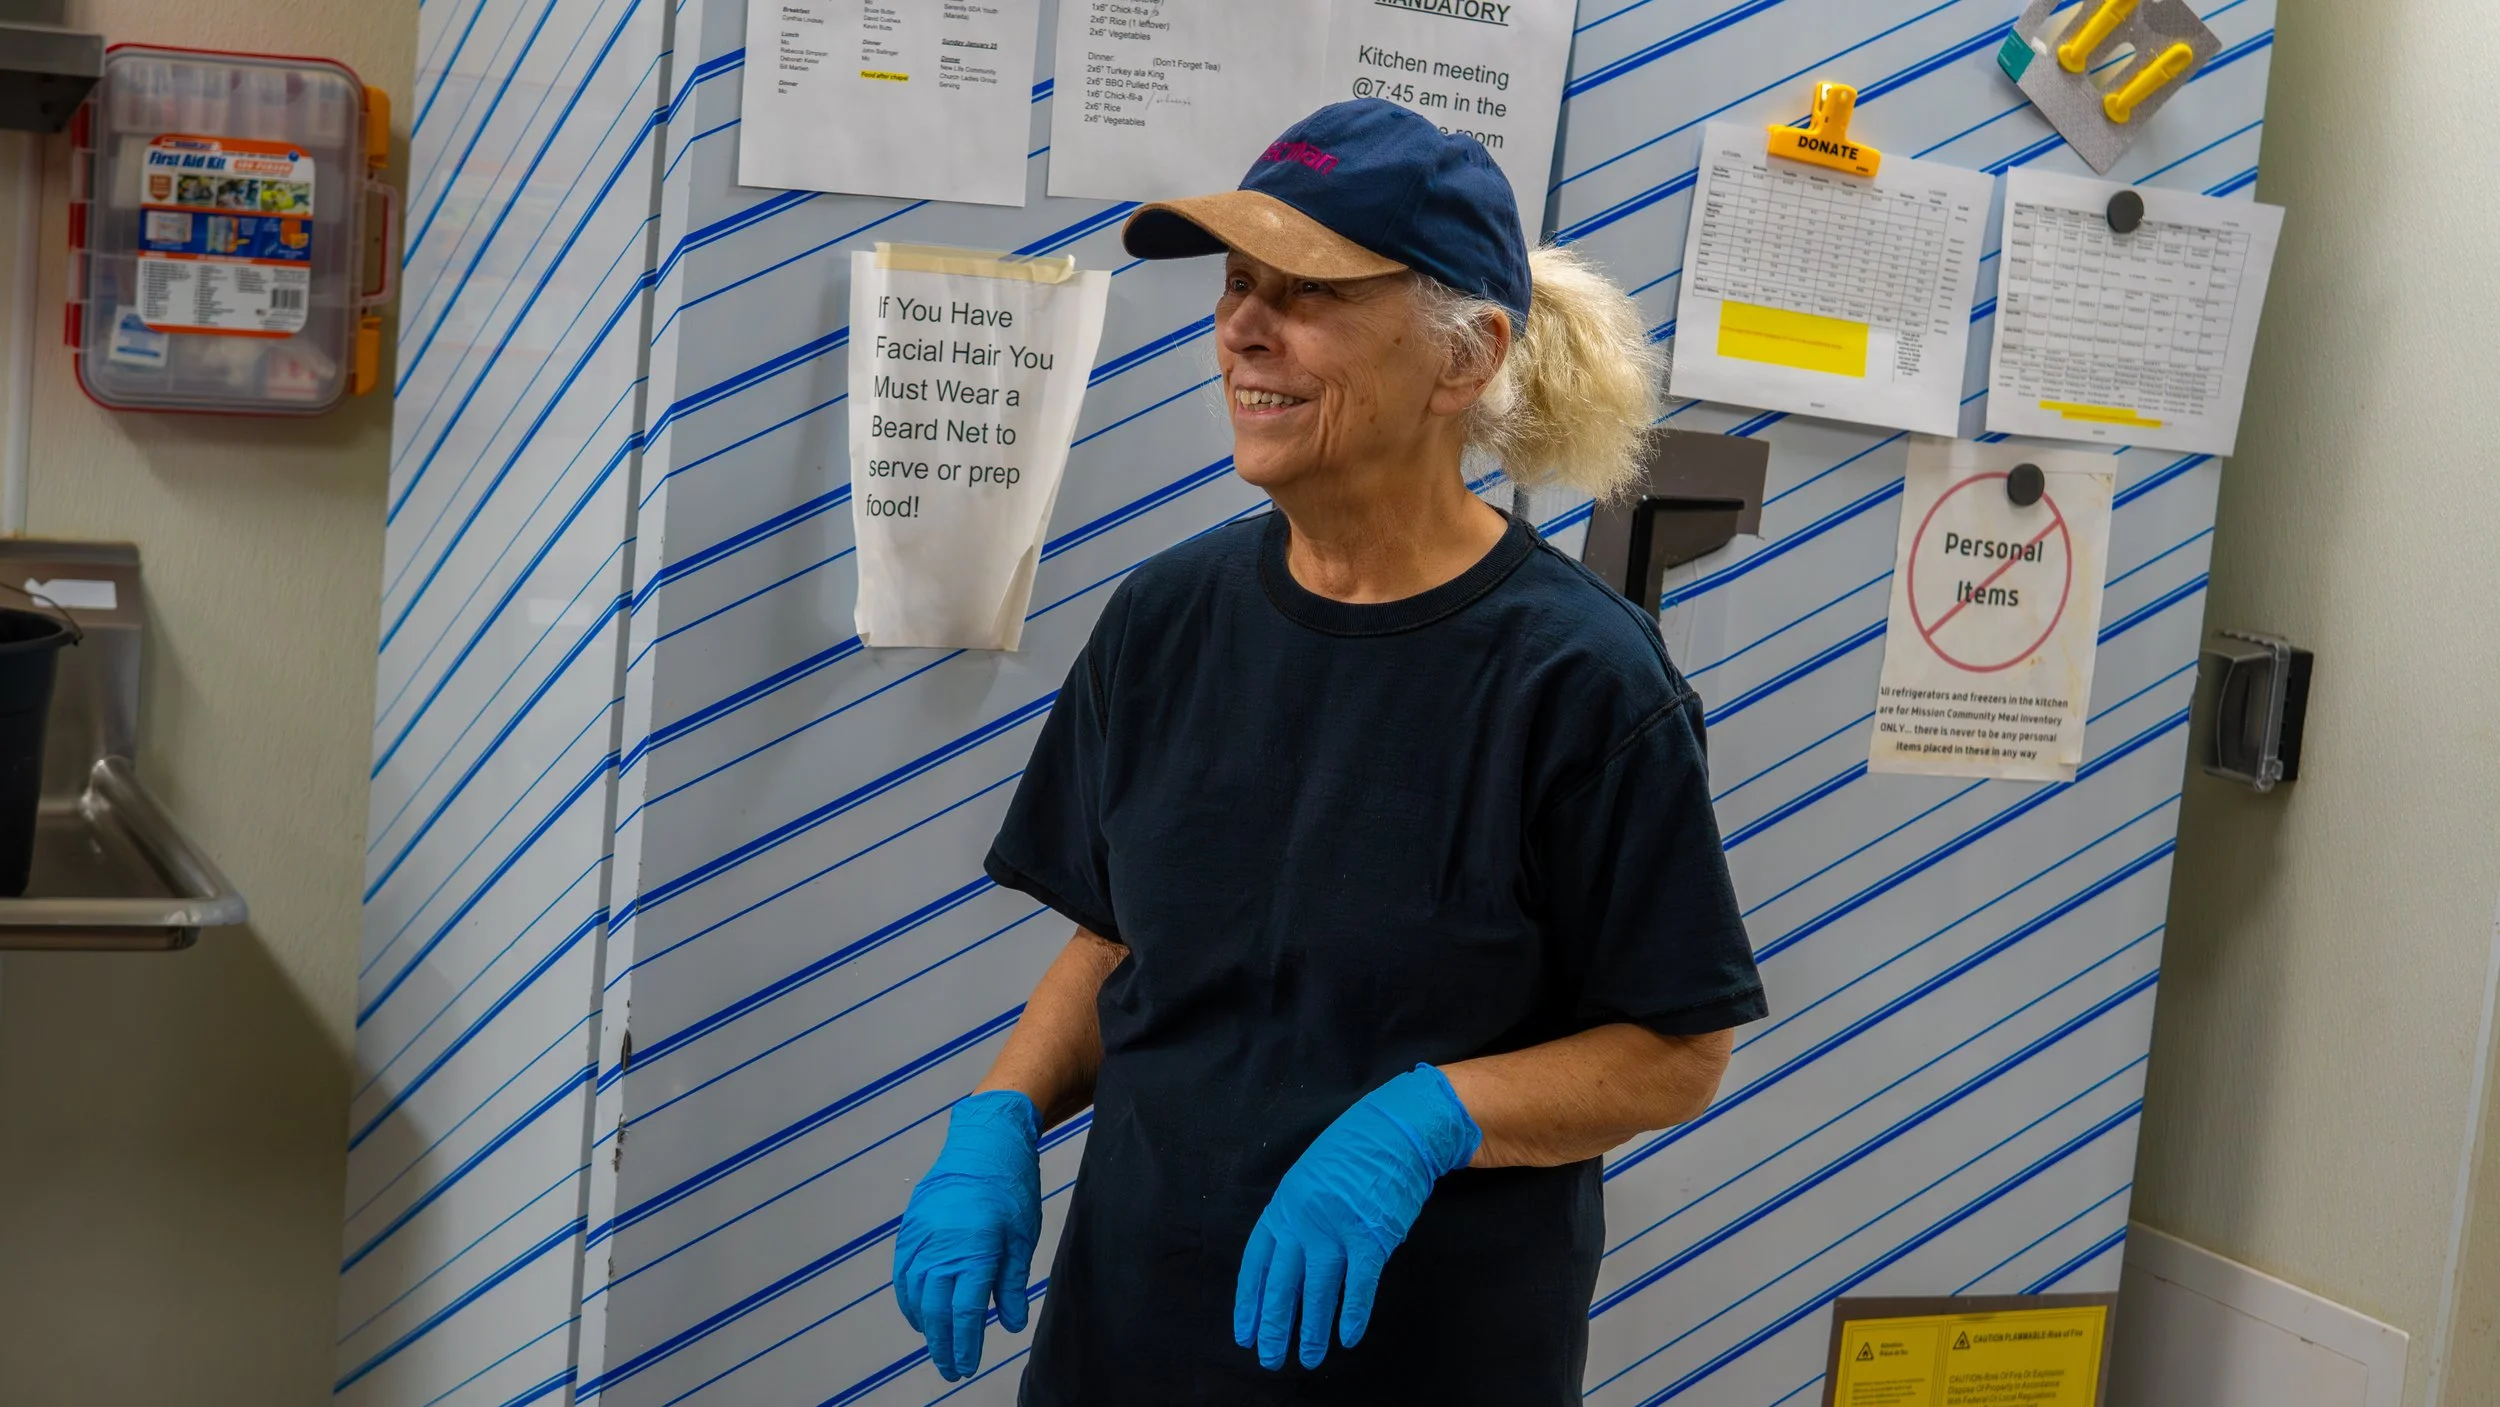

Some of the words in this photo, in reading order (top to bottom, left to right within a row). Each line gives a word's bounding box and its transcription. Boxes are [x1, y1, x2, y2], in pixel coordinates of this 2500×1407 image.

[1092, 3, 1108, 11] 1x6"
[1110, 6, 1148, 16] Chick-fil-a
[1090, 15, 1108, 24] 2x6"
[1109, 17, 1127, 26] Rice
[1089, 28, 1107, 36] 2x6"
[1108, 30, 1151, 40] Vegetables
[966, 67, 996, 75] Community
[1087, 65, 1104, 73] 2x6"
[1107, 66, 1132, 77] Turkey
[1148, 70, 1165, 80] King
[1178, 60, 1202, 71] Forget
[1205, 62, 1221, 73] Tea)
[1358, 45, 1428, 74] Kitchen
[1433, 61, 1510, 91] meeting
[1086, 77, 1103, 86] 2x6"
[1105, 79, 1123, 88] BBQ
[1126, 80, 1149, 90] Pulled
[1151, 82, 1169, 91] Pork
[1104, 91, 1143, 101] Chick-fil-a
[1352, 77, 1414, 103] @7:45
[1419, 90, 1448, 109] am
[1454, 93, 1470, 112] in
[1476, 96, 1507, 118] the
[1085, 102, 1102, 111] 2x6"
[1104, 103, 1121, 112] Rice
[1084, 114, 1101, 122] 2x6"
[1103, 116, 1145, 126] Vegetables
[1798, 135, 1859, 161] DONATE
[149, 152, 180, 167] First
[182, 154, 206, 168] Aid
[206, 157, 227, 170] Kit
[878, 296, 890, 319] If
[896, 297, 942, 323] You
[951, 301, 1013, 328] Have
[875, 336, 944, 363] Facial
[952, 341, 1002, 366] Hair
[1009, 345, 1054, 371] You
[874, 375, 928, 401] Must
[936, 380, 999, 406] Wear
[1006, 386, 1020, 407] a
[872, 416, 938, 442] Beard
[946, 420, 988, 445] Net
[996, 424, 1016, 445] to
[868, 458, 929, 479] serve
[937, 462, 961, 482] or
[969, 463, 1021, 489] prep
[866, 494, 920, 518] food!
[1944, 532, 2043, 563] Personal
[1957, 581, 2019, 607] Items
[1892, 688, 1950, 701] refrigerators
[1952, 693, 1968, 703] and
[1970, 694, 2007, 705] freezers
[2009, 695, 2017, 704] in
[2019, 697, 2033, 706] the
[2035, 698, 2068, 709] kitchen
[1879, 705, 1893, 714] are
[1896, 705, 1909, 715] for
[1911, 707, 1945, 718] Mission
[1947, 709, 1996, 722] Community
[1999, 713, 2019, 722] Meal
[1914, 726, 1939, 736] there
[1940, 726, 1948, 736] is
[1950, 728, 1975, 738] never
[1978, 729, 1987, 738] to
[1989, 729, 1999, 739] be
[2001, 731, 2017, 741] any
[2019, 732, 2057, 743] personal
[1923, 743, 1953, 754] placed
[1955, 744, 1963, 754] in
[1965, 745, 1989, 756] these
[1991, 747, 2000, 756] in
[2001, 748, 2017, 758] any
[2020, 749, 2037, 759] way
[1973, 1334, 2004, 1343] CAUTION
[1963, 1394, 1987, 1404] Federal
